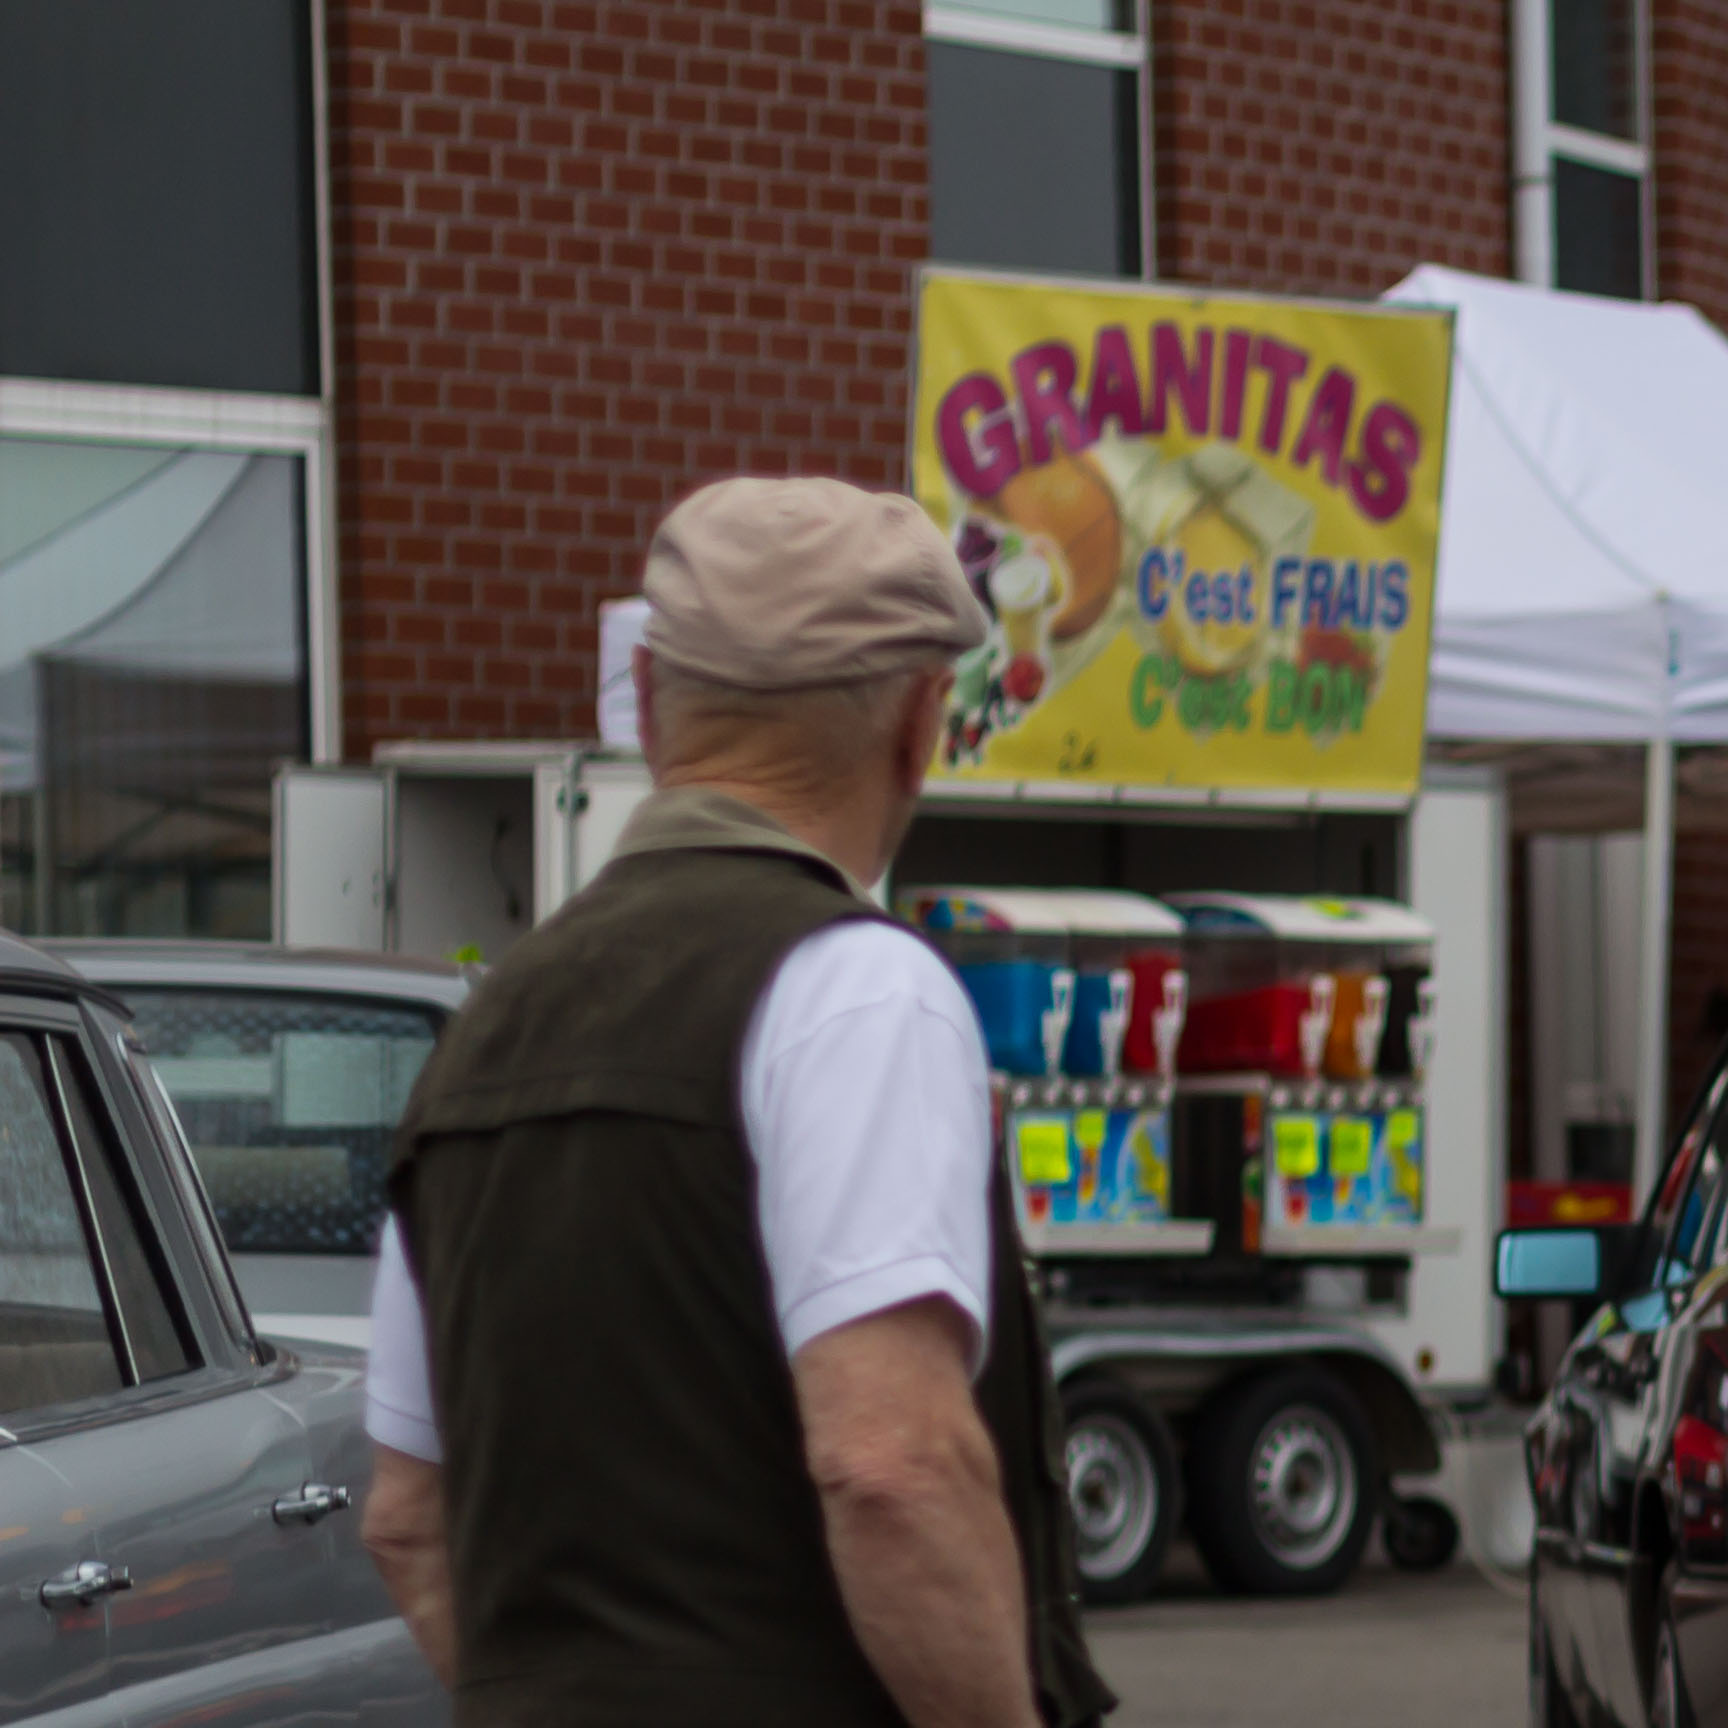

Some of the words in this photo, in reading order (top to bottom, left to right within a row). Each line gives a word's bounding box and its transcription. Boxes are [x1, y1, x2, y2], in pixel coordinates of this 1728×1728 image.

[936, 320, 1420, 523] GRANITAS
[1137, 547, 1255, 624] C'est
[1271, 554, 1409, 634] FRAIS
[1129, 653, 1253, 733] C'est
[1263, 656, 1369, 735] BON
